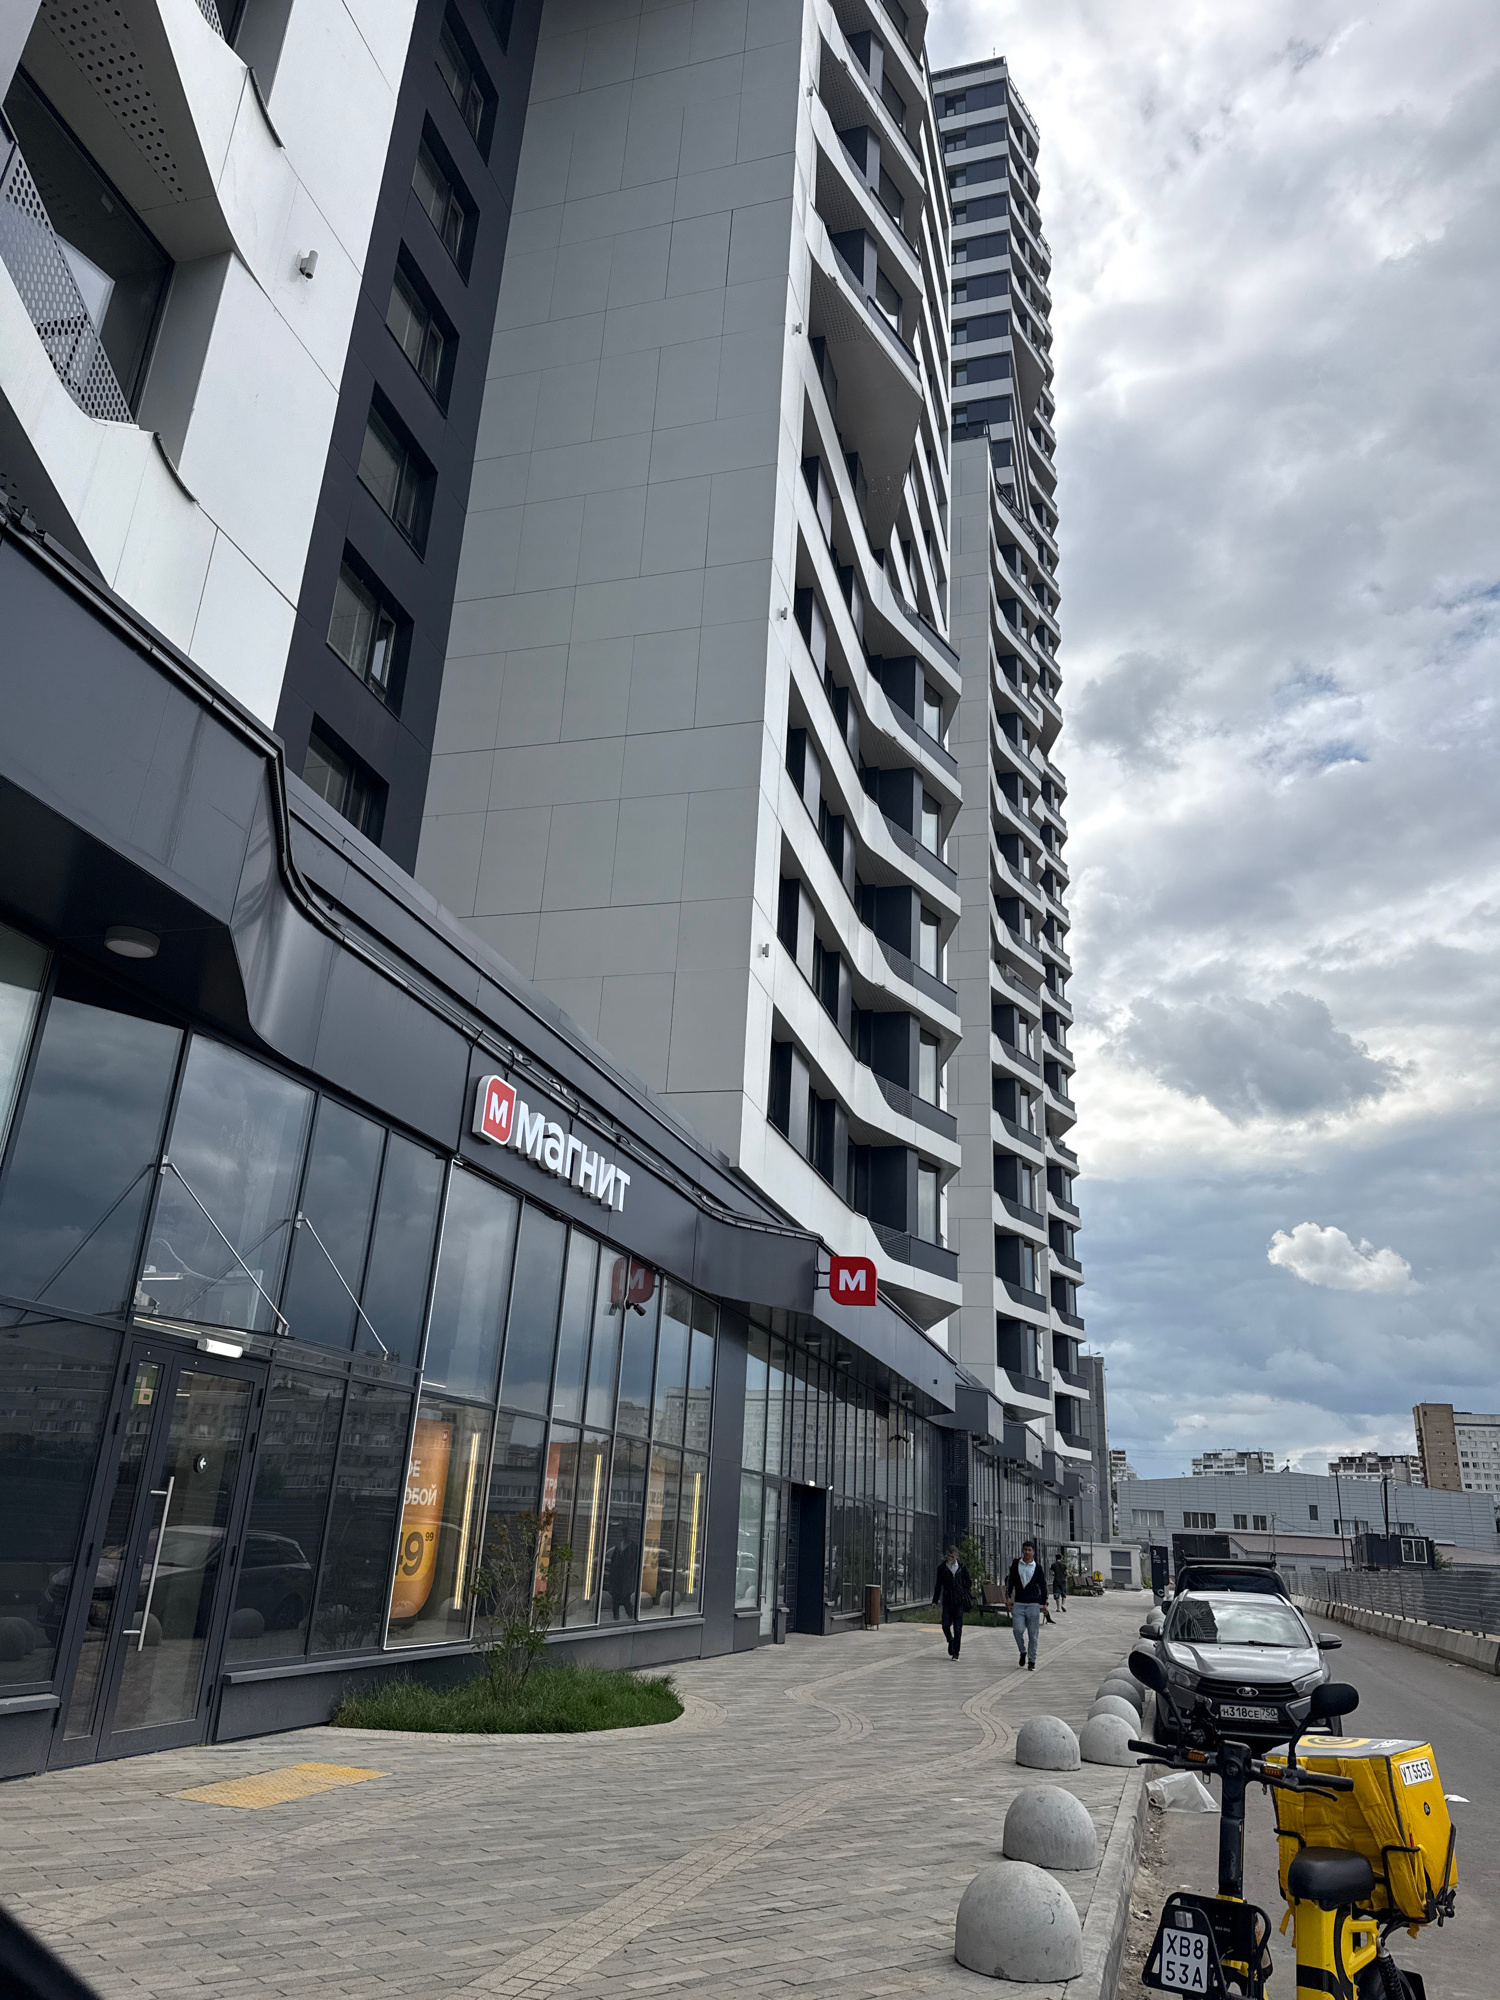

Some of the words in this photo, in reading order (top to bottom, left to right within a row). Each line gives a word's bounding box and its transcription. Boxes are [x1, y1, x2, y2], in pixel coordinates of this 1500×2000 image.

[489, 1092, 508, 1128] М
[515, 1101, 630, 1212] Магнит
[839, 1269, 866, 1291] М
[425, 1532, 434, 1541] 99
